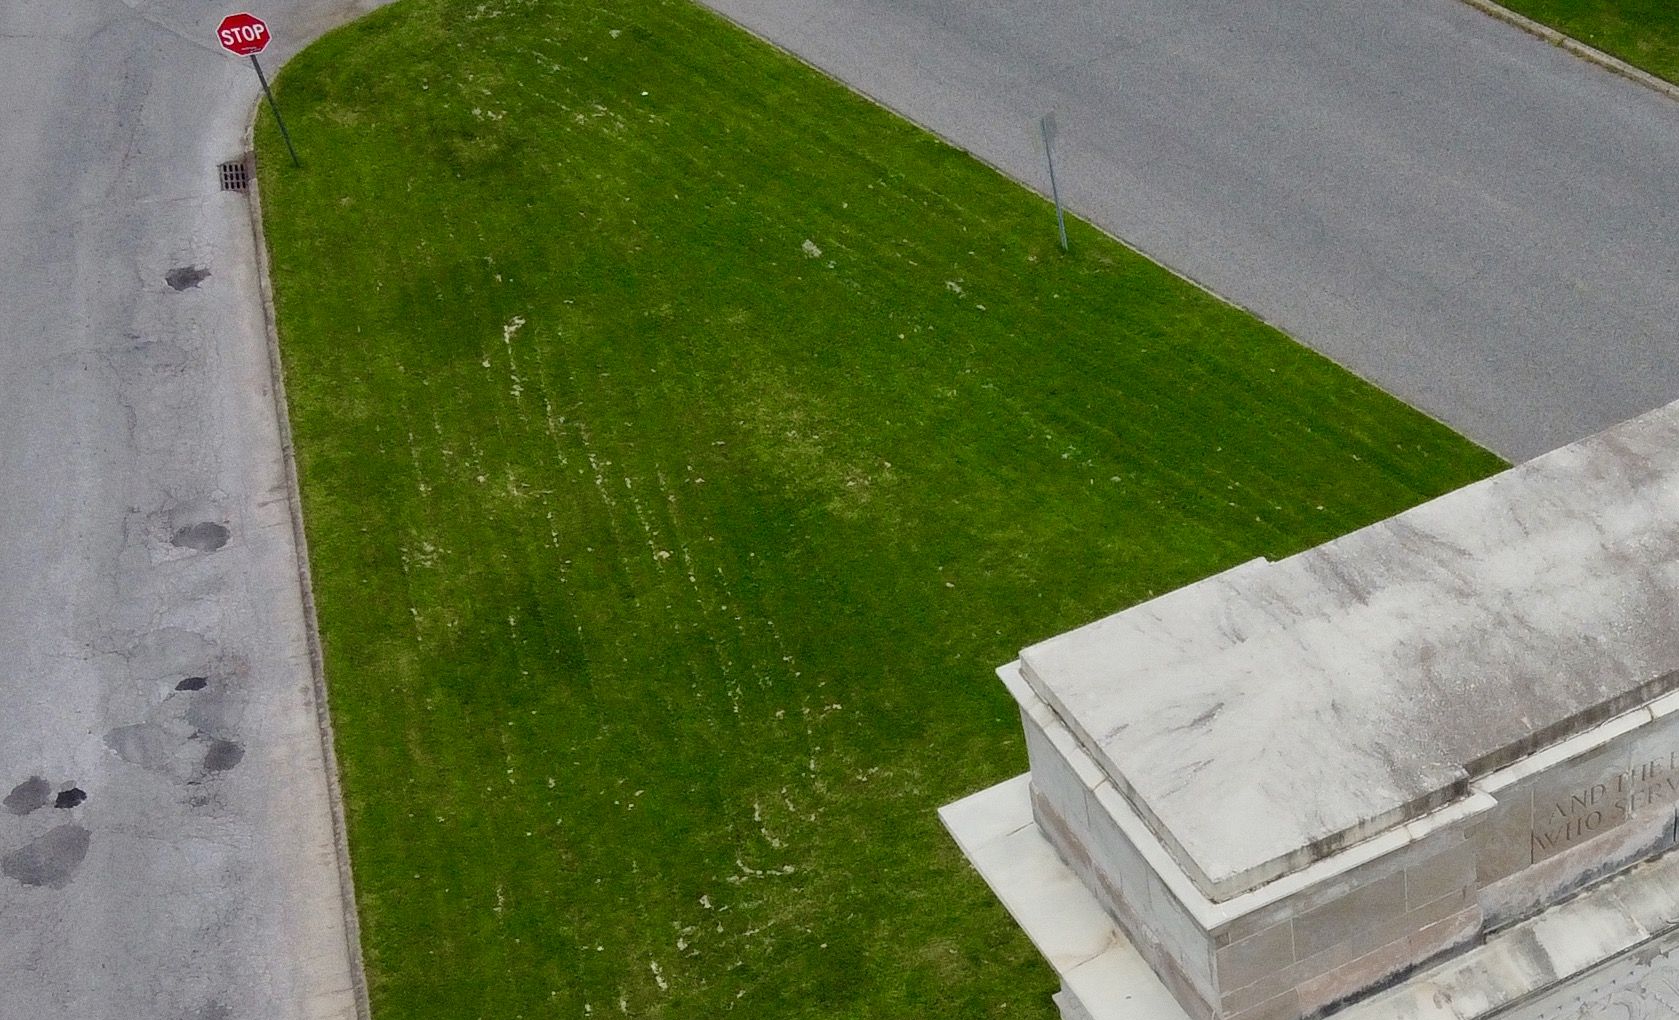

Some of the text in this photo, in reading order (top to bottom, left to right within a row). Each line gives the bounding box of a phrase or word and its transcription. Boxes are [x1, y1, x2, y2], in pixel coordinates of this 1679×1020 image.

[221, 23, 265, 46] STOP
[1549, 783, 1607, 825] AND
[1614, 756, 1664, 793] THE
[1532, 810, 1602, 850] WHO
